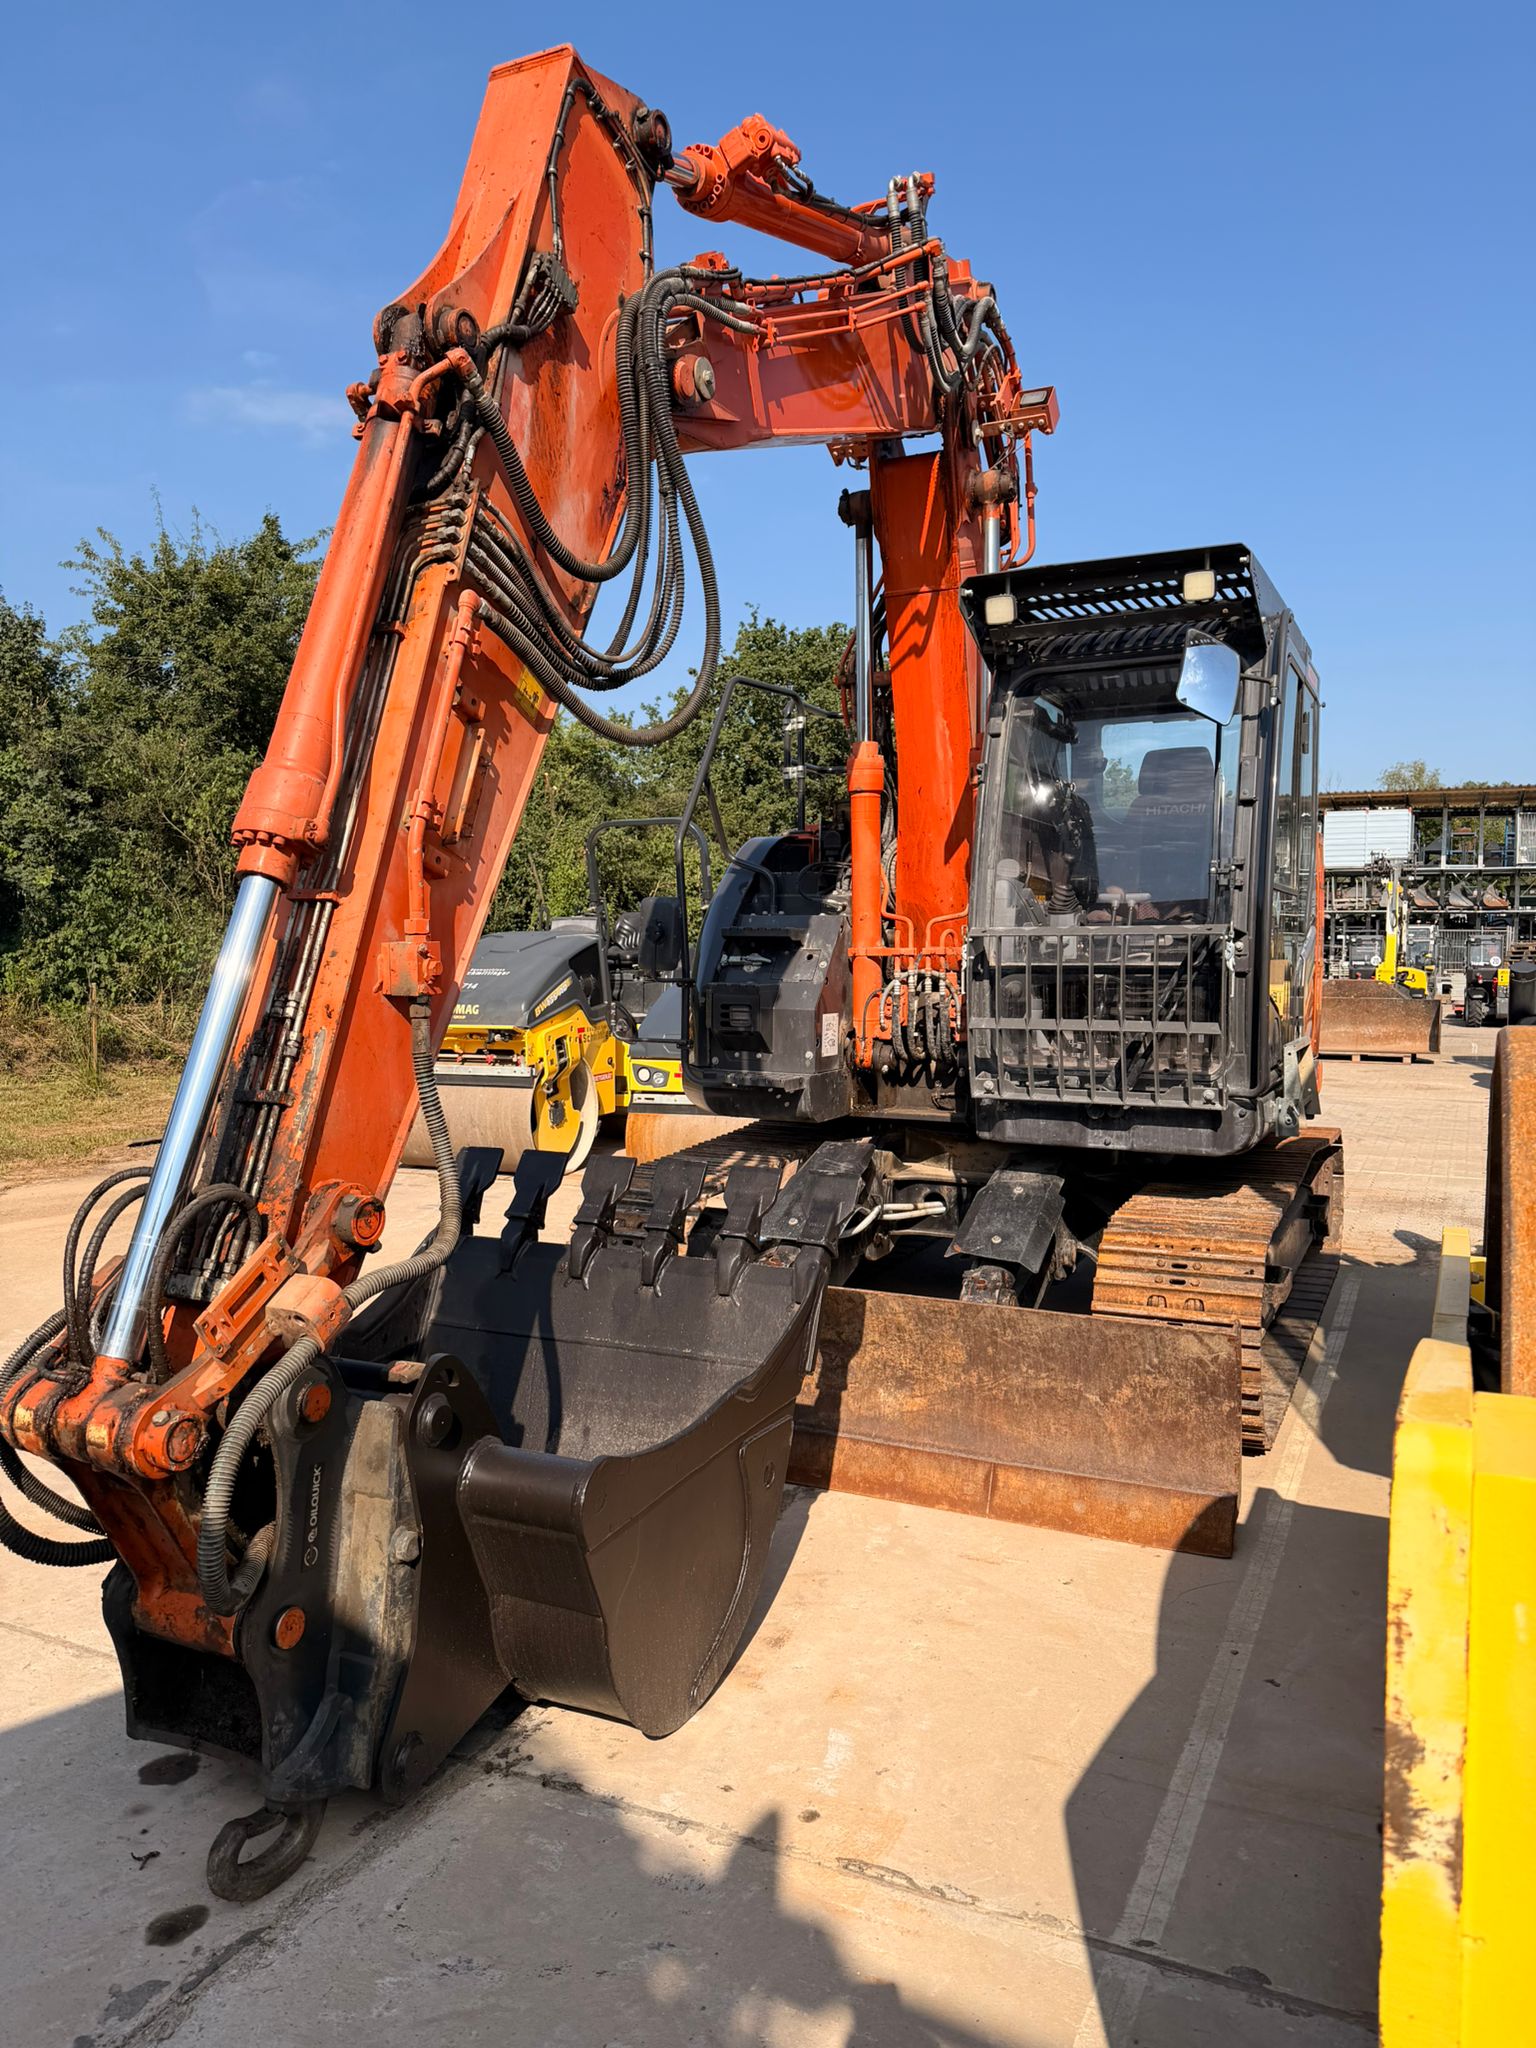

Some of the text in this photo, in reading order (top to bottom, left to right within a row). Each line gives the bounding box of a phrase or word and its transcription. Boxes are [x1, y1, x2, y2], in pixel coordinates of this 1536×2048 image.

[1146, 803, 1206, 816] HITACHI
[453, 1004, 479, 1014] MAG
[310, 1466, 321, 1526] OILQUICK
